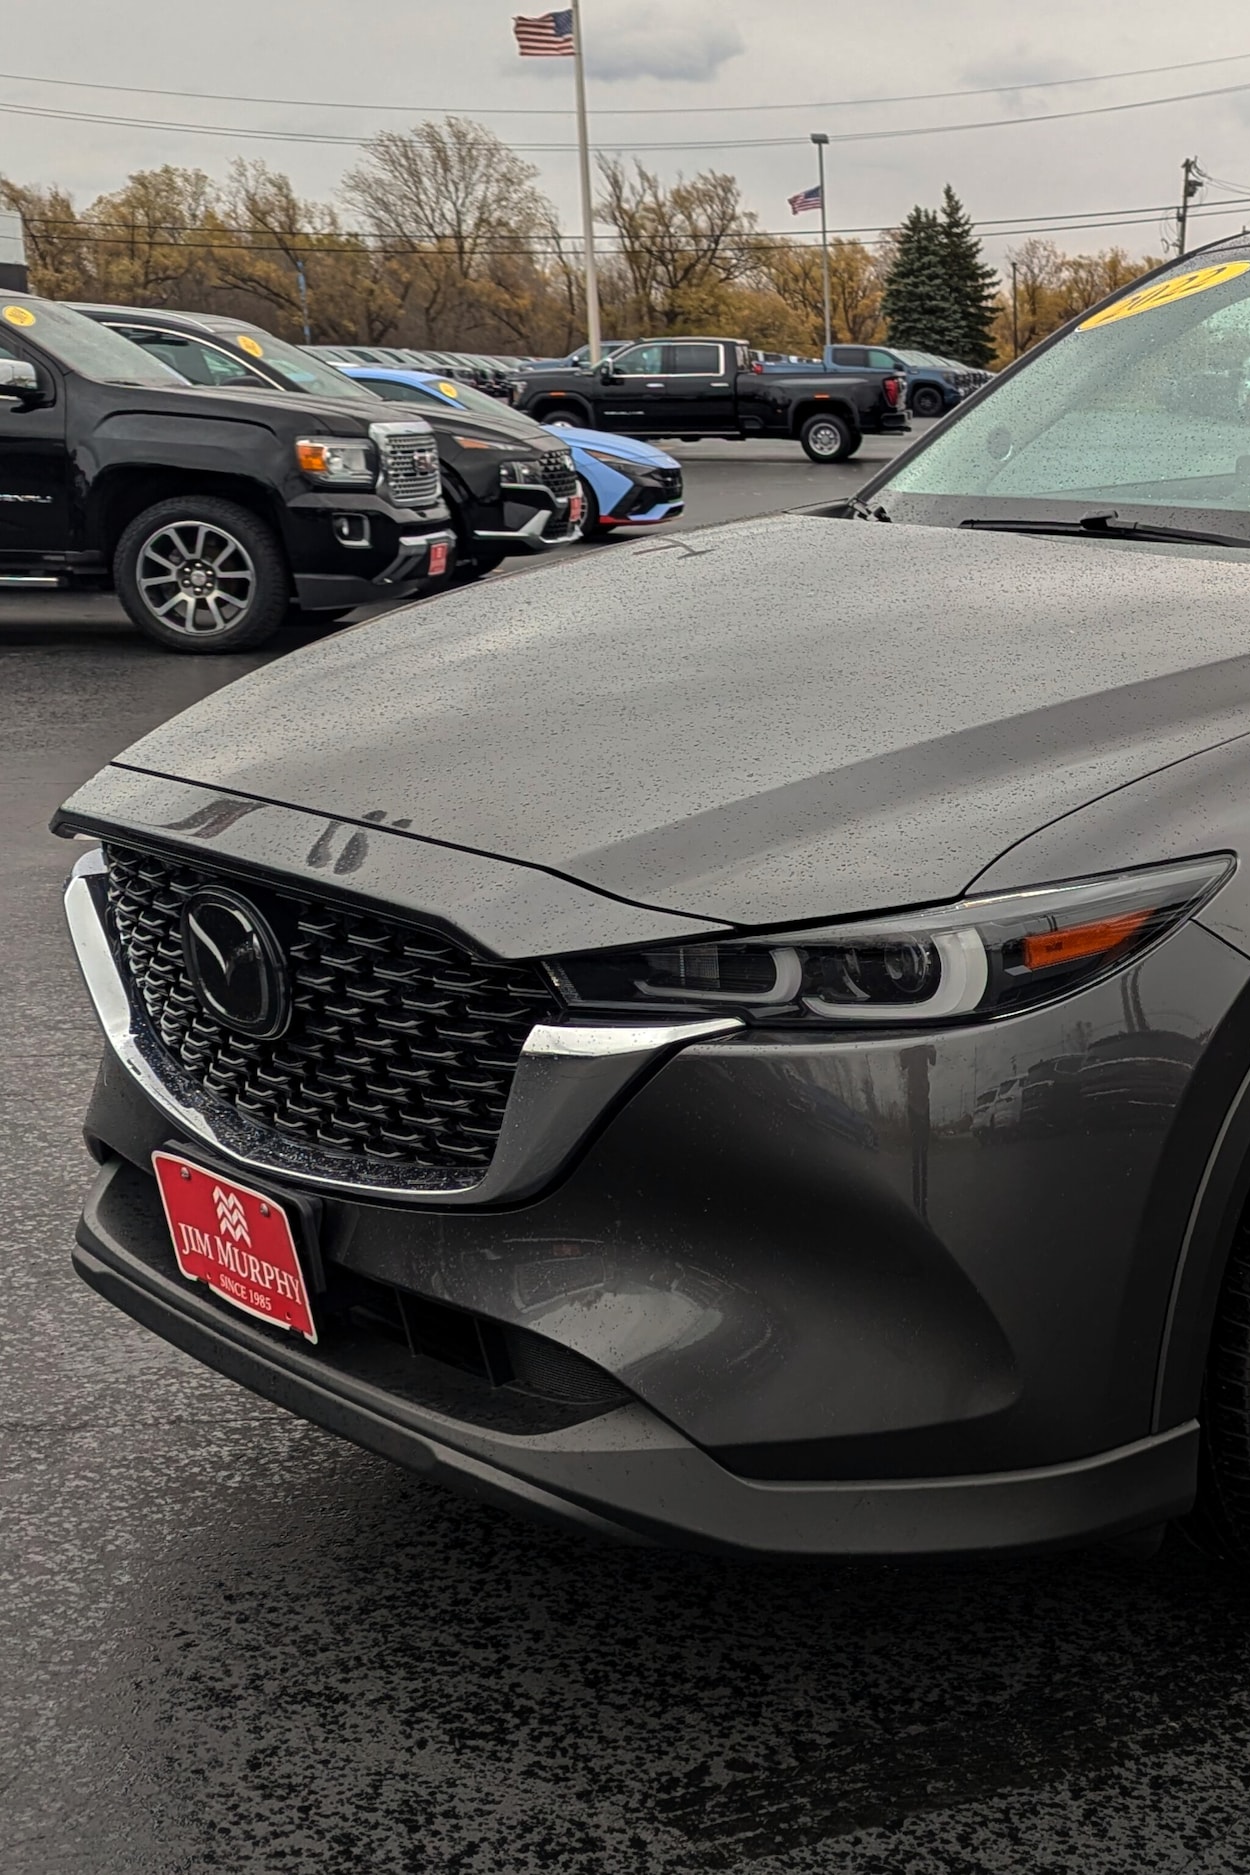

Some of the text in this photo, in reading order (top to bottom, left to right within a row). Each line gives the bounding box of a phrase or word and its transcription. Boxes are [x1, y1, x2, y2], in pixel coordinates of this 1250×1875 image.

[177, 1222, 303, 1305] JIM MURPHY
[219, 1273, 273, 1311] SINCE 1985
